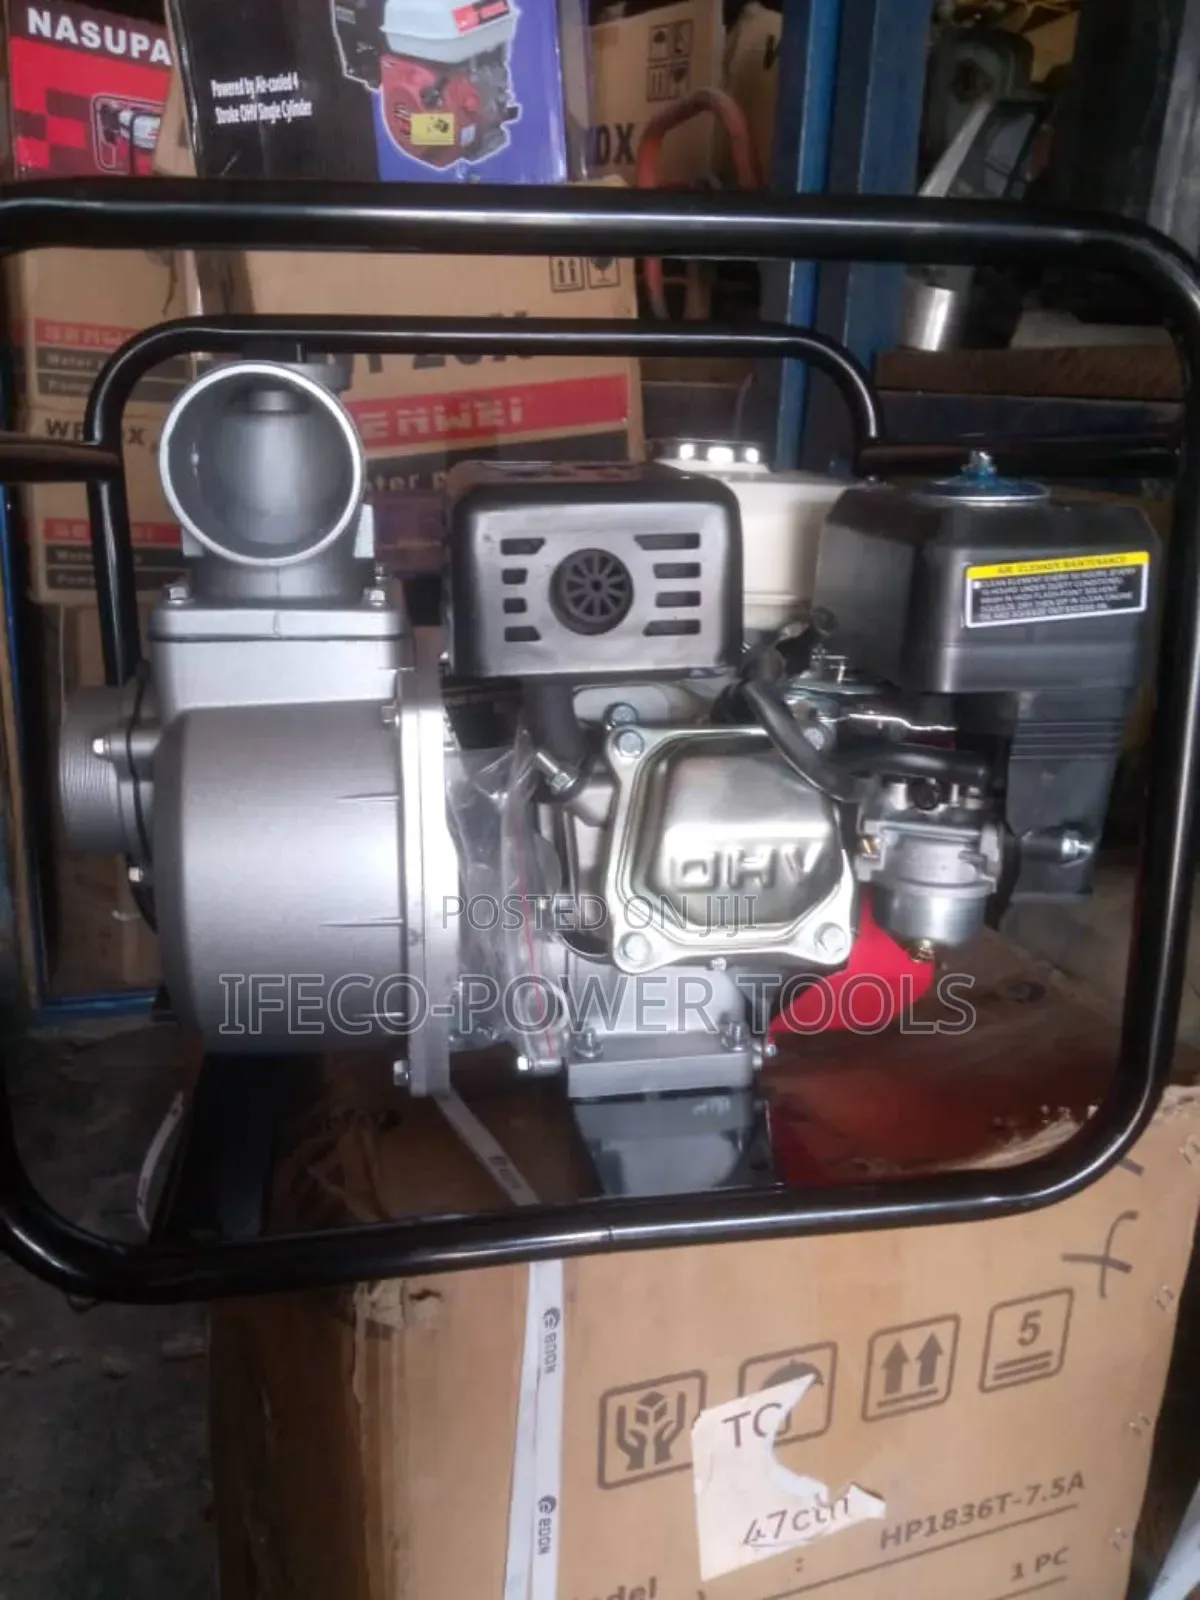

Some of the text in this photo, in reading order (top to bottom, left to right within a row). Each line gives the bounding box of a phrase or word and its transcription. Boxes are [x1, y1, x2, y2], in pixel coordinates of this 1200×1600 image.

[27, 7, 172, 66] NASUPA
[358, 397, 523, 439] ENWEI
[1017, 1309, 1042, 1346] 5
[879, 1470, 1086, 1551] HP1836T-7.5A
[1034, 1546, 1071, 1574] PC
